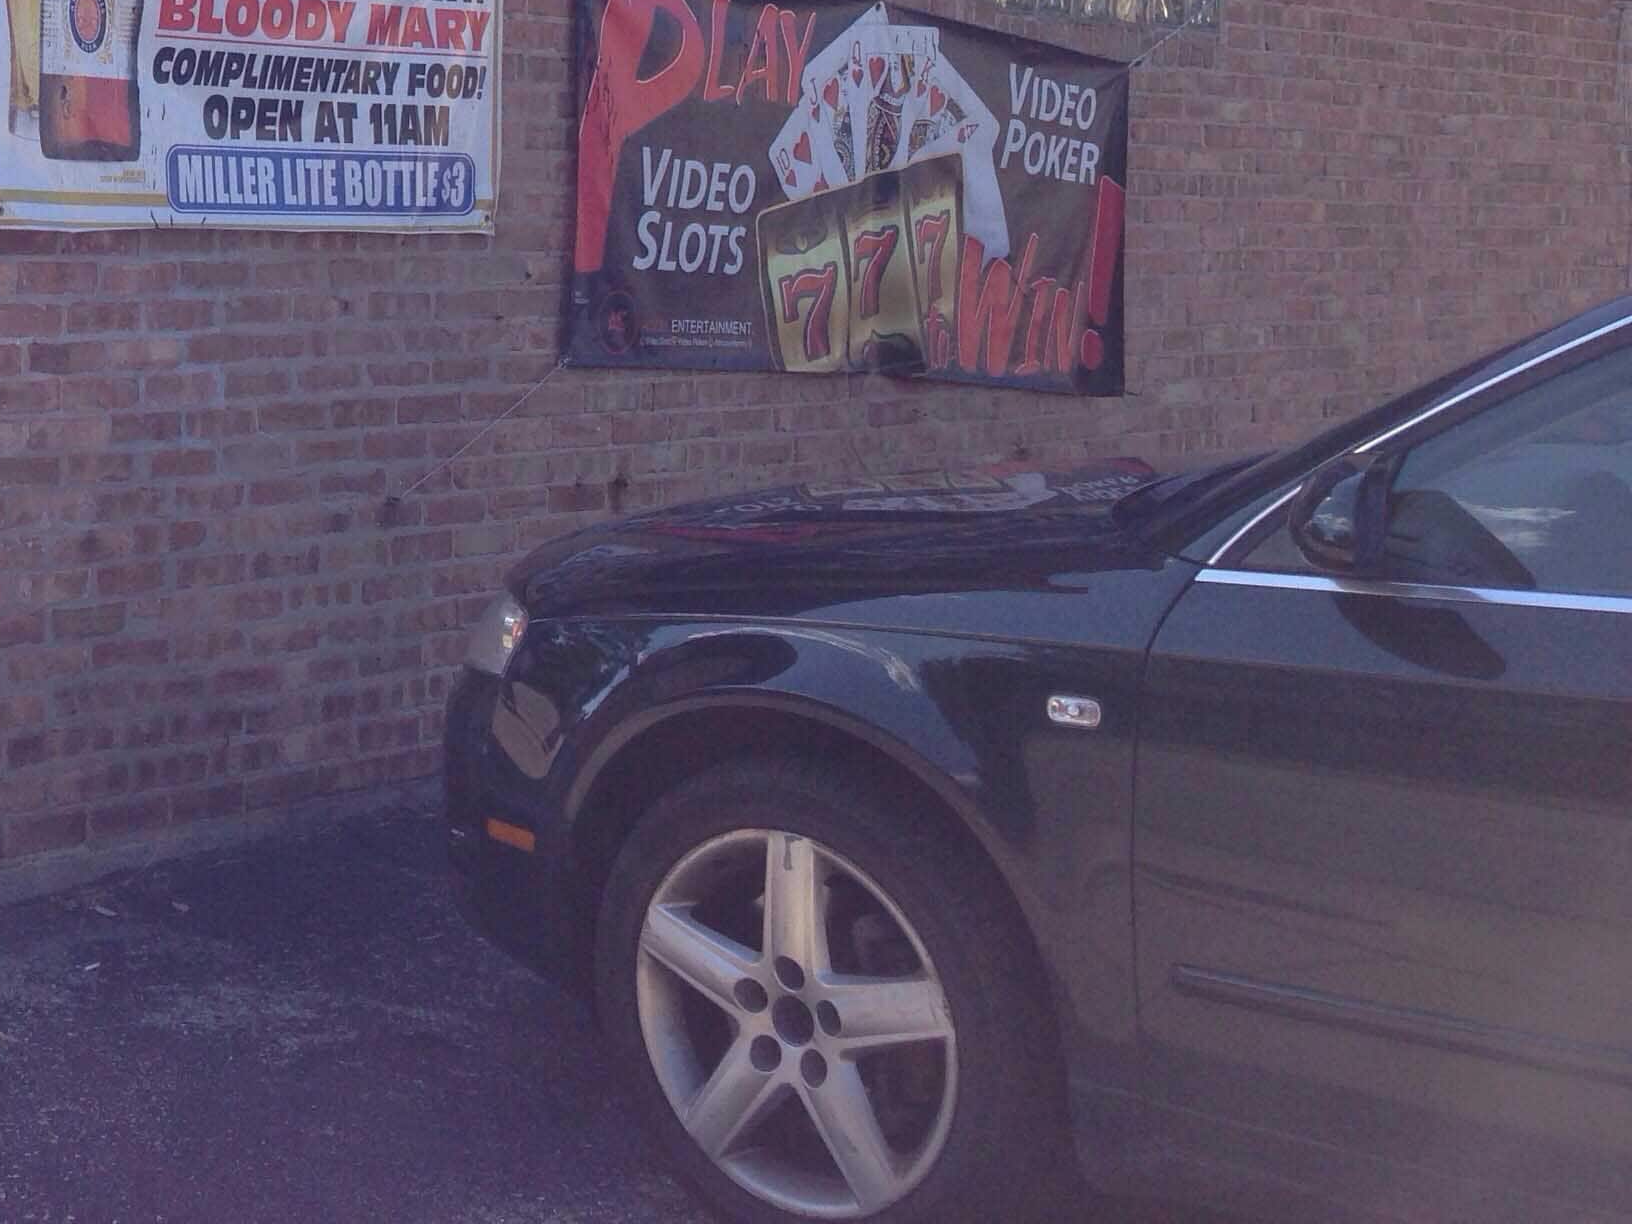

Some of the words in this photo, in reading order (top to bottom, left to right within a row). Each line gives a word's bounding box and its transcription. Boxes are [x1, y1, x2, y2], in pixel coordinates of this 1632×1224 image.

[368, 5, 491, 51] MARY
[153, 46, 399, 96] COMPLIMENTARY
[407, 62, 487, 100] FOOD!
[1008, 63, 1097, 130] VIDEO
[203, 93, 303, 142] OPEN
[314, 102, 357, 144] AT
[369, 103, 450, 146] 11AM
[1000, 119, 1100, 185] POKER
[178, 153, 276, 206] MILLER
[284, 156, 338, 207] LITE
[344, 159, 438, 208] BOTTLE
[443, 162, 465, 208] $3
[640, 147, 756, 213] VIDEO
[633, 210, 747, 275] SLOTS
[779, 261, 840, 364] 7
[851, 224, 898, 320] 7
[958, 176, 1125, 376] WIN!
[671, 319, 753, 336] ENTERTAINMENT
